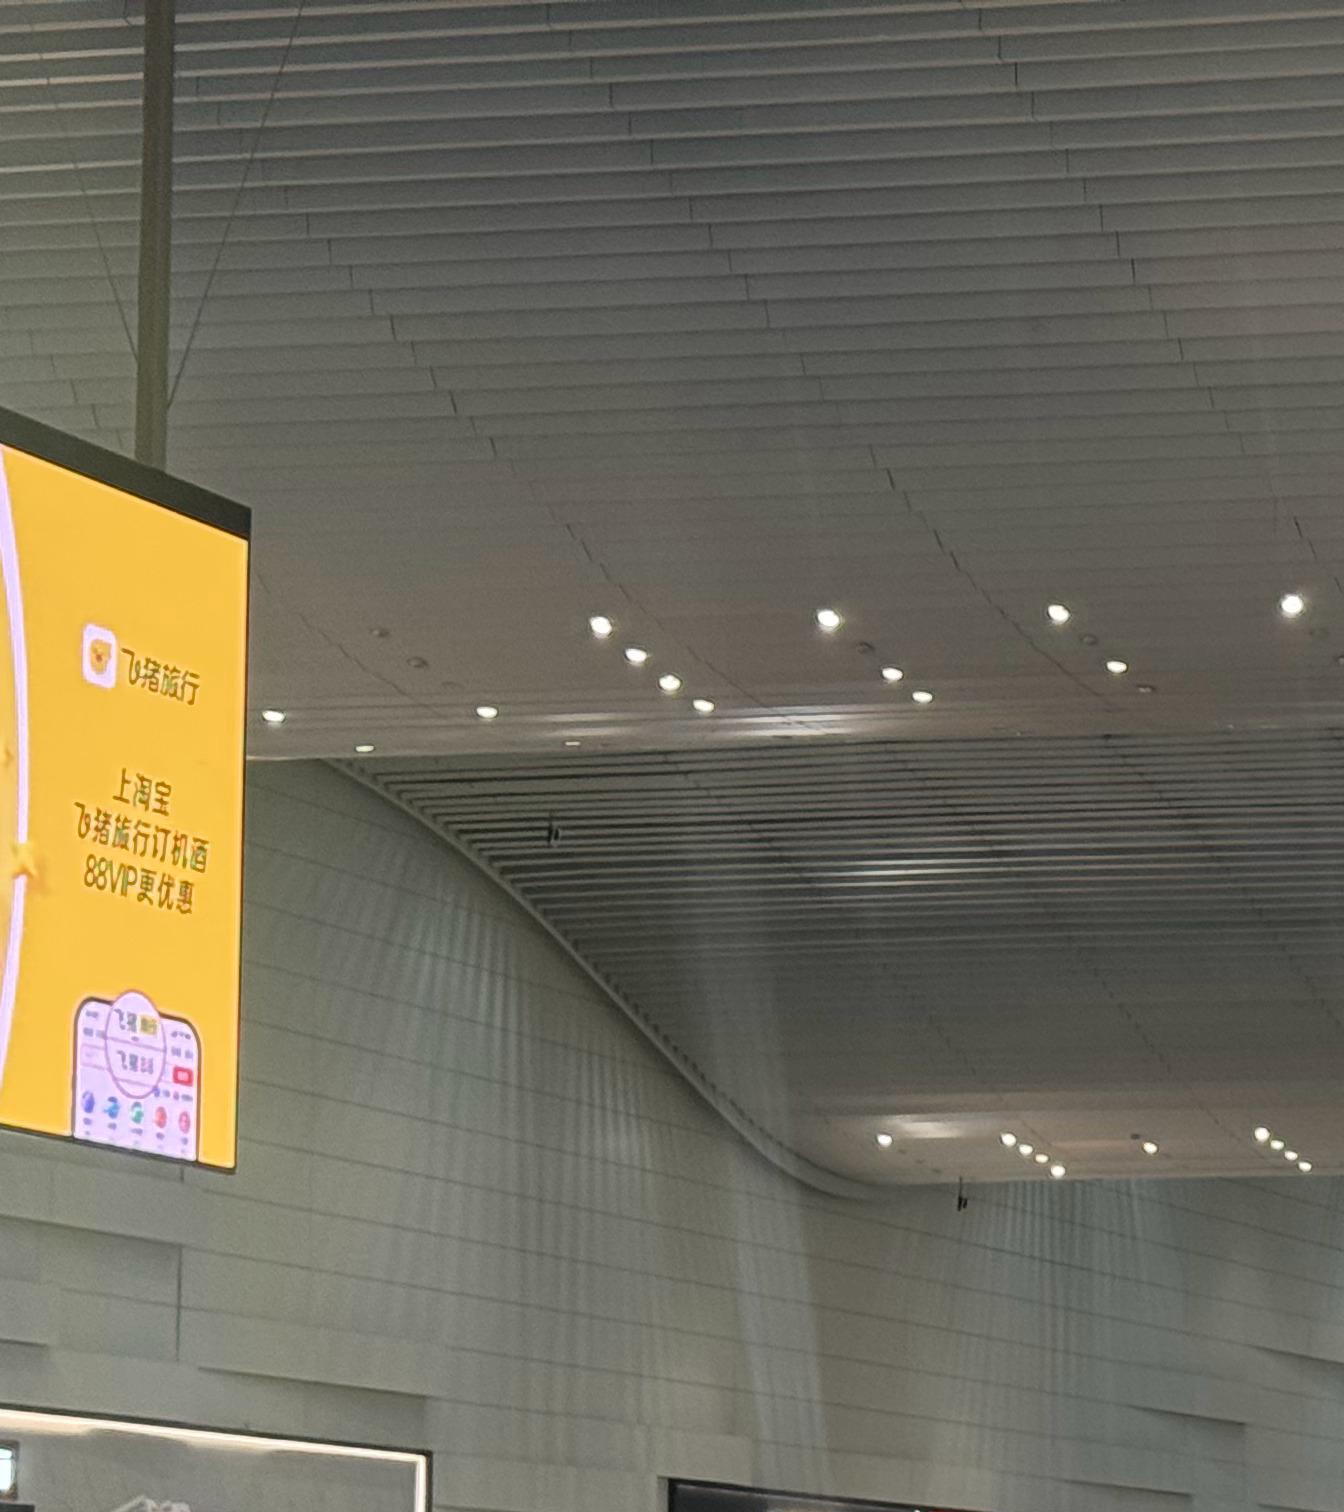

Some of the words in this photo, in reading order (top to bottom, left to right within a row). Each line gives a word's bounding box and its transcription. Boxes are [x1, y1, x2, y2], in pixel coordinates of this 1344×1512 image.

[121, 647, 199, 705] 飞猪旅行
[112, 767, 171, 817] 上淘宝
[74, 801, 209, 873] 飞猪旅行订机酒
[84, 853, 195, 914] 88VIP更优惠
